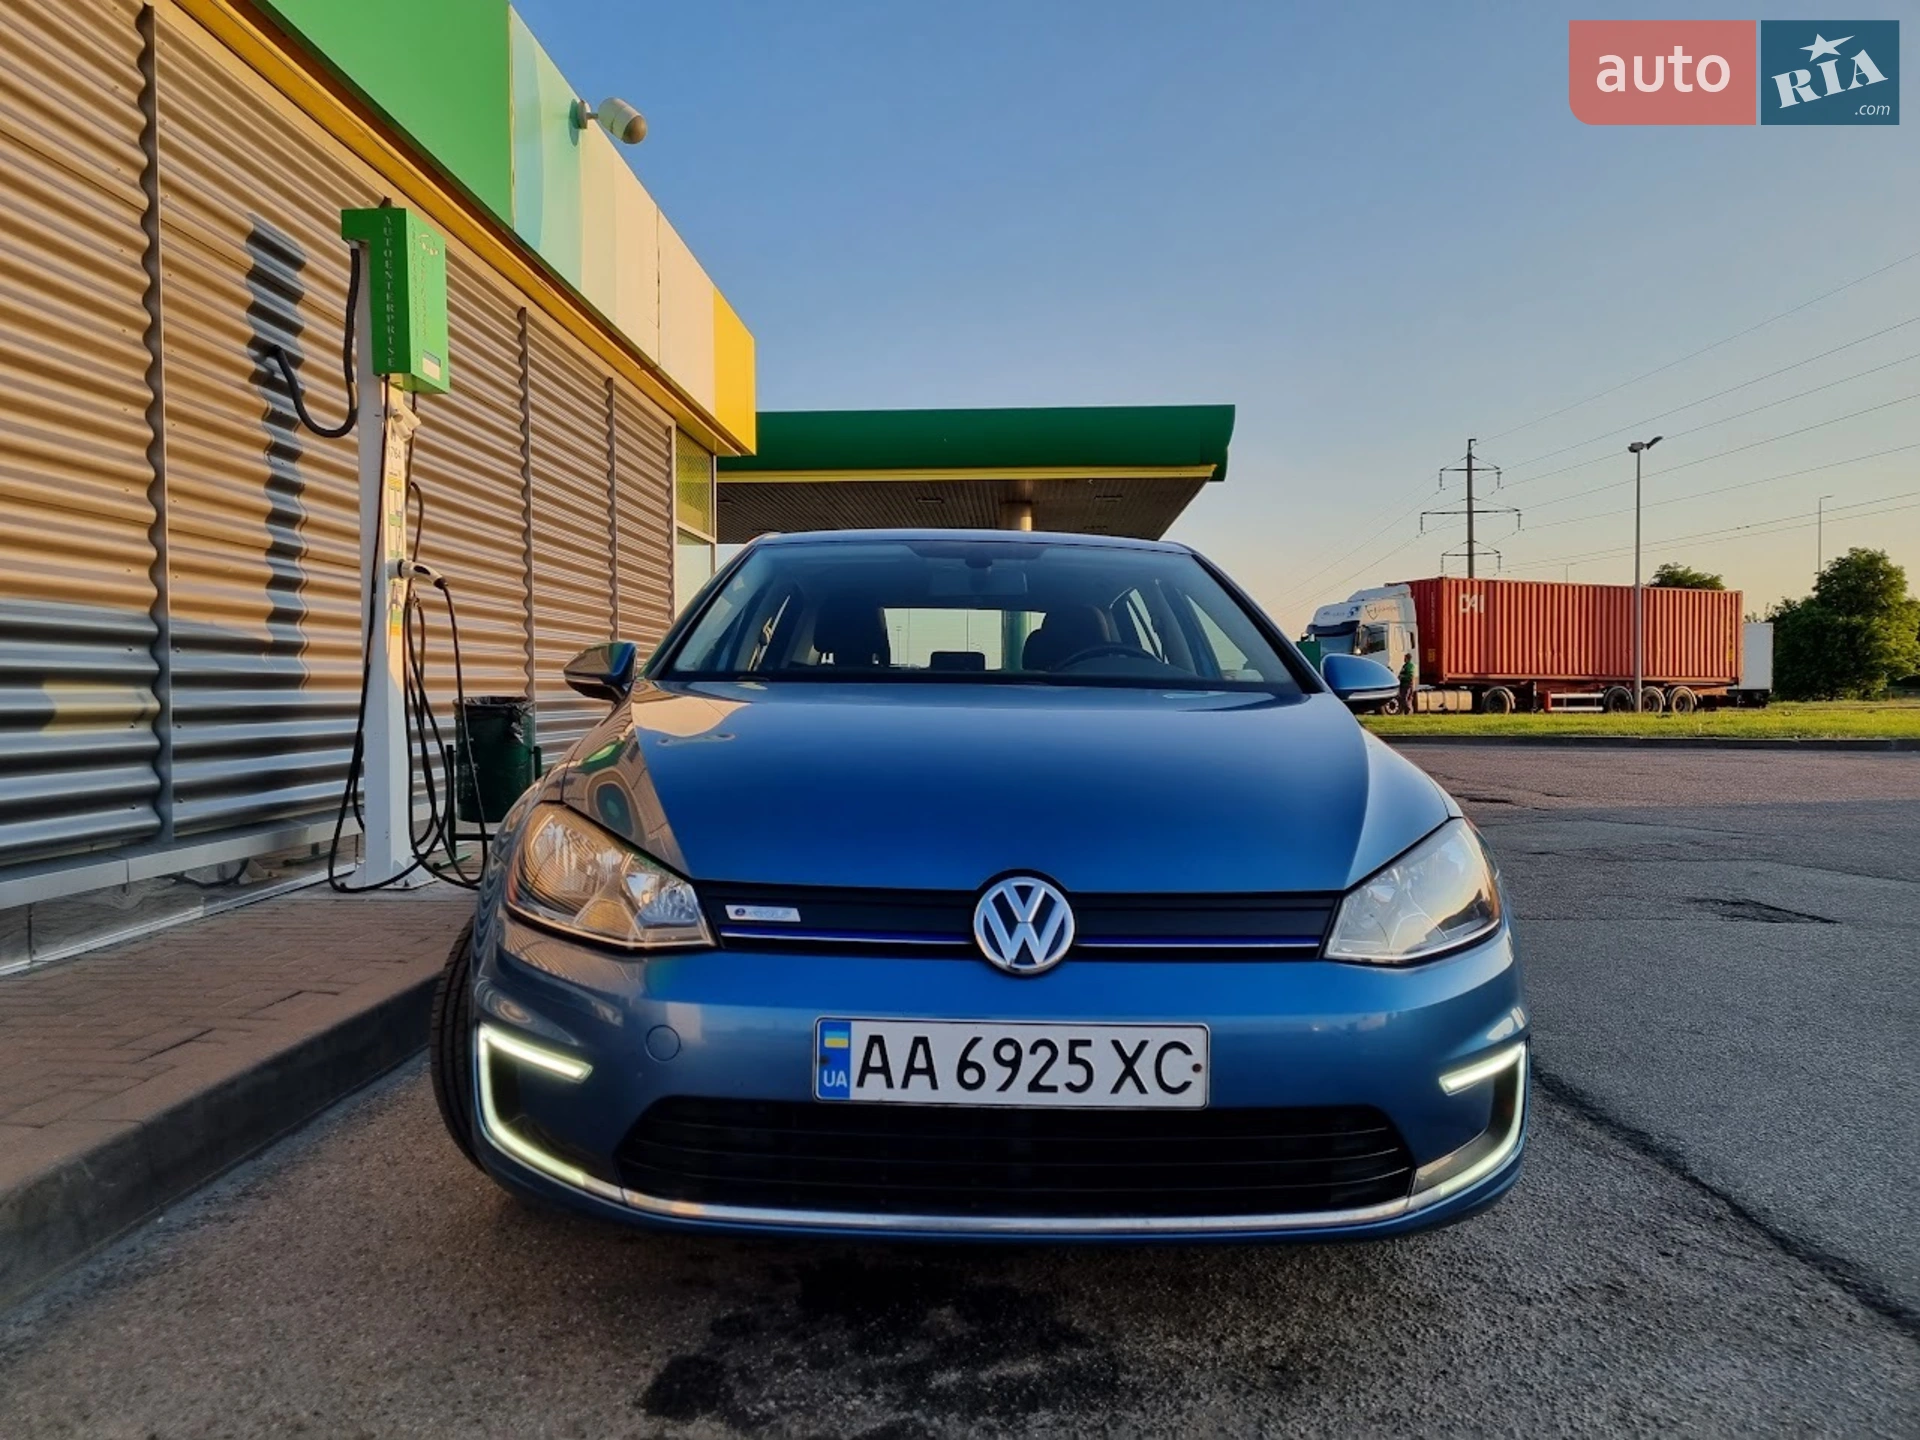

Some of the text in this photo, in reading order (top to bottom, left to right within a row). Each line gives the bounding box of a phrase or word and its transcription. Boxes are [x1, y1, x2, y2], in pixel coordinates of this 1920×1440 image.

[975, 877, 1074, 974] VW
[823, 1070, 848, 1088] UA
[856, 1034, 1193, 1095] AA 6925 XC
